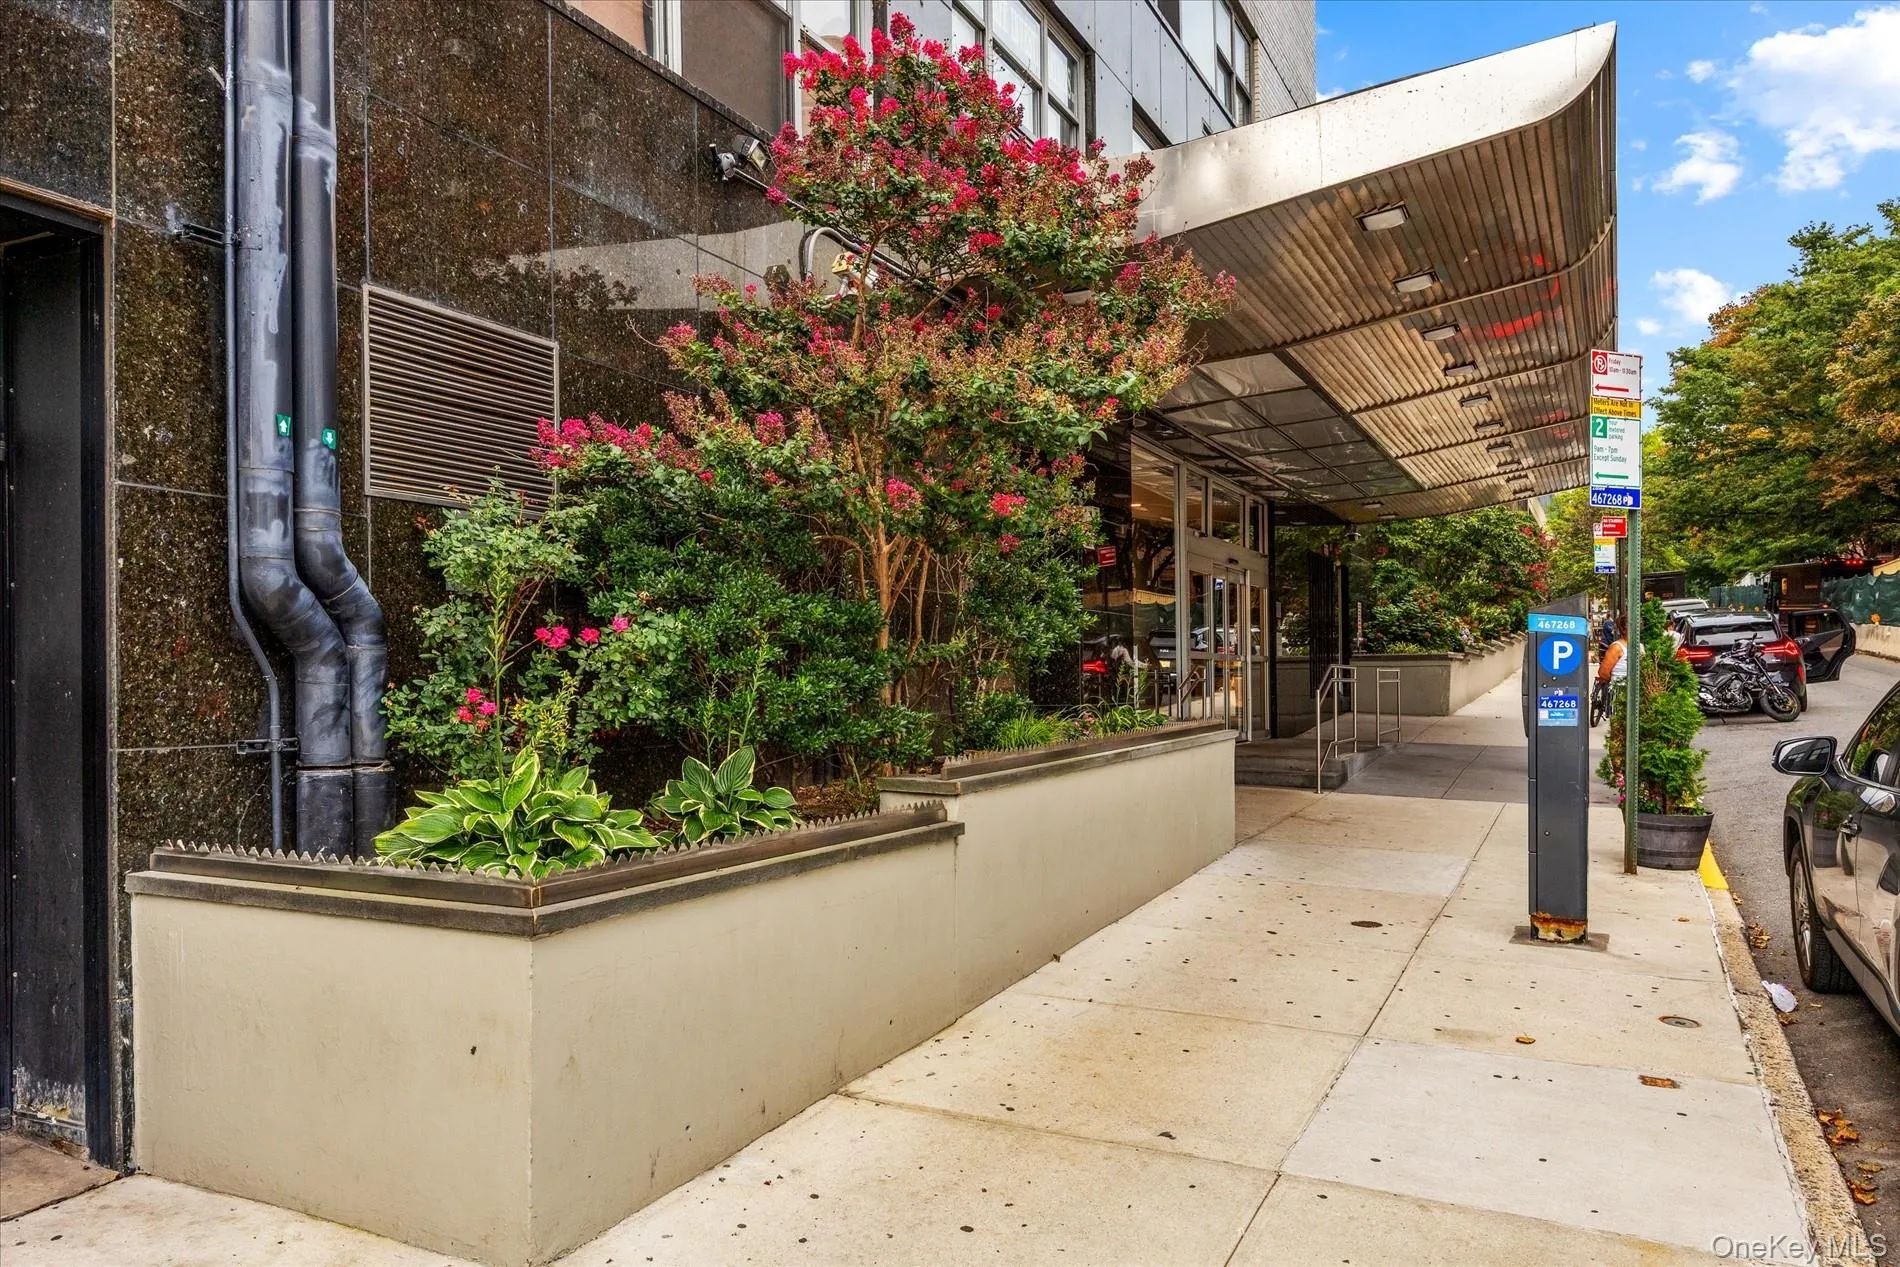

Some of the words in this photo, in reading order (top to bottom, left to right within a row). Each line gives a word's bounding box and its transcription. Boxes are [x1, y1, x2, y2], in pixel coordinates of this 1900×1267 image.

[1609, 357, 1621, 366] Friday
[1594, 398, 1609, 406] Meters
[1620, 400, 1628, 408] Not
[1594, 407, 1607, 415] Effect
[1608, 409, 1622, 417] Above
[1624, 410, 1636, 418] Times
[1595, 418, 1604, 436] 2
[1608, 446, 1618, 454] 7pm
[1594, 453, 1609, 462] Except
[1610, 454, 1627, 464] Sunday
[1592, 492, 1622, 506] 467268
[1537, 620, 1576, 629] 467268
[1553, 640, 1574, 670] P
[1541, 699, 1576, 708] 467268
